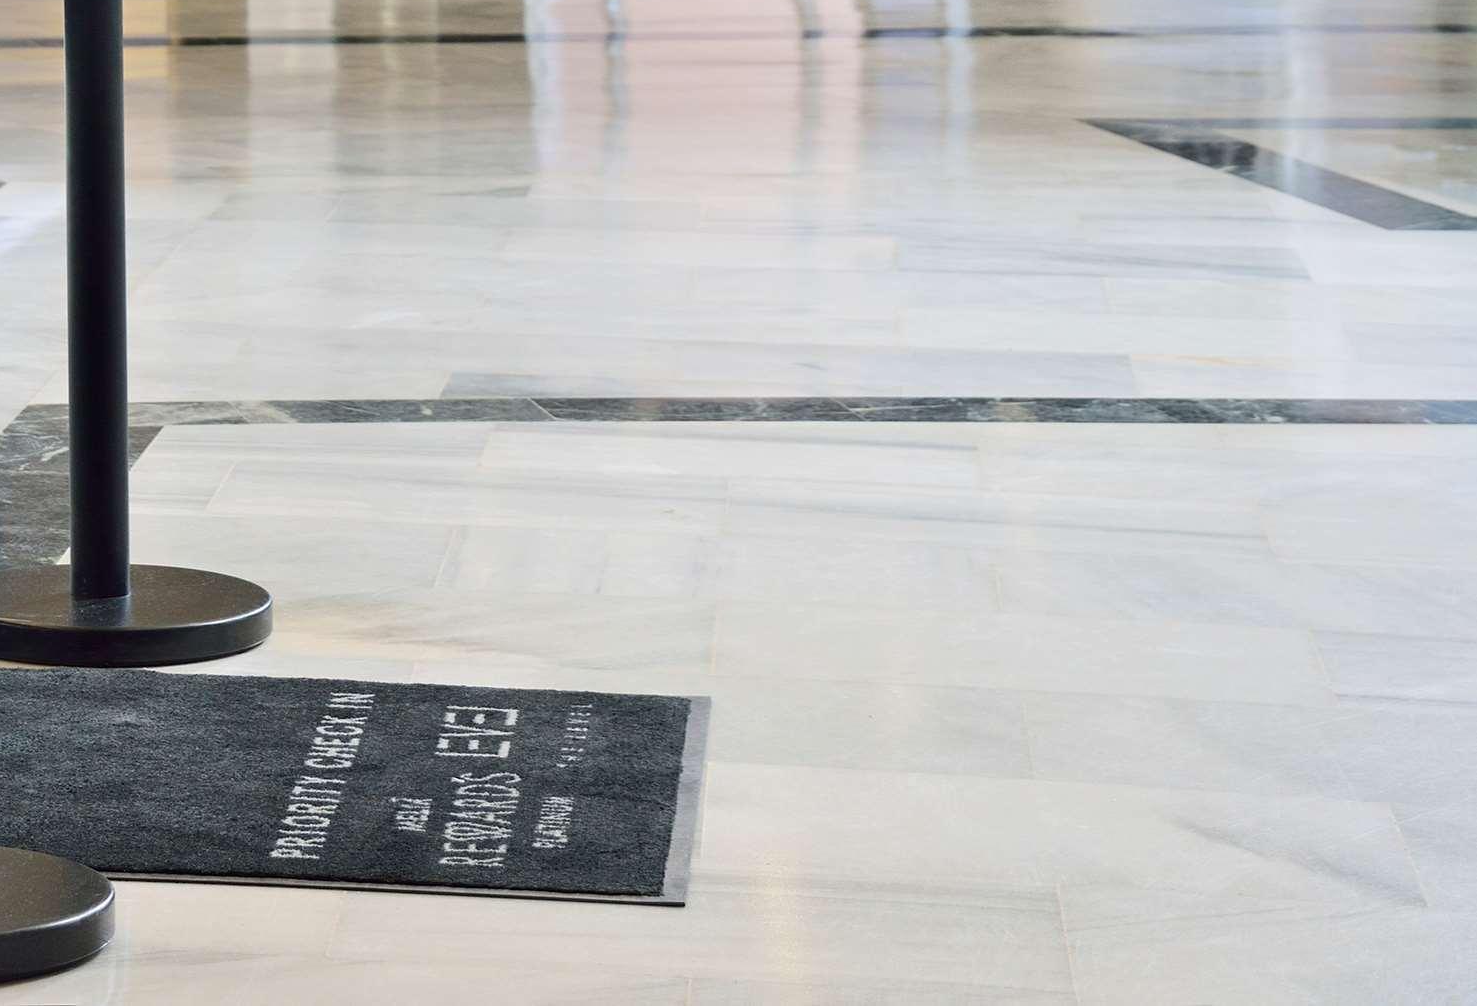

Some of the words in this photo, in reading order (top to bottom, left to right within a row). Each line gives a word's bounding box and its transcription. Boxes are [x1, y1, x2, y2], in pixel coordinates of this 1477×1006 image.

[327, 692, 376, 710] IN
[304, 714, 368, 770] CHECK
[269, 774, 347, 860] PRIORITY
[439, 772, 522, 868] REWARDS
